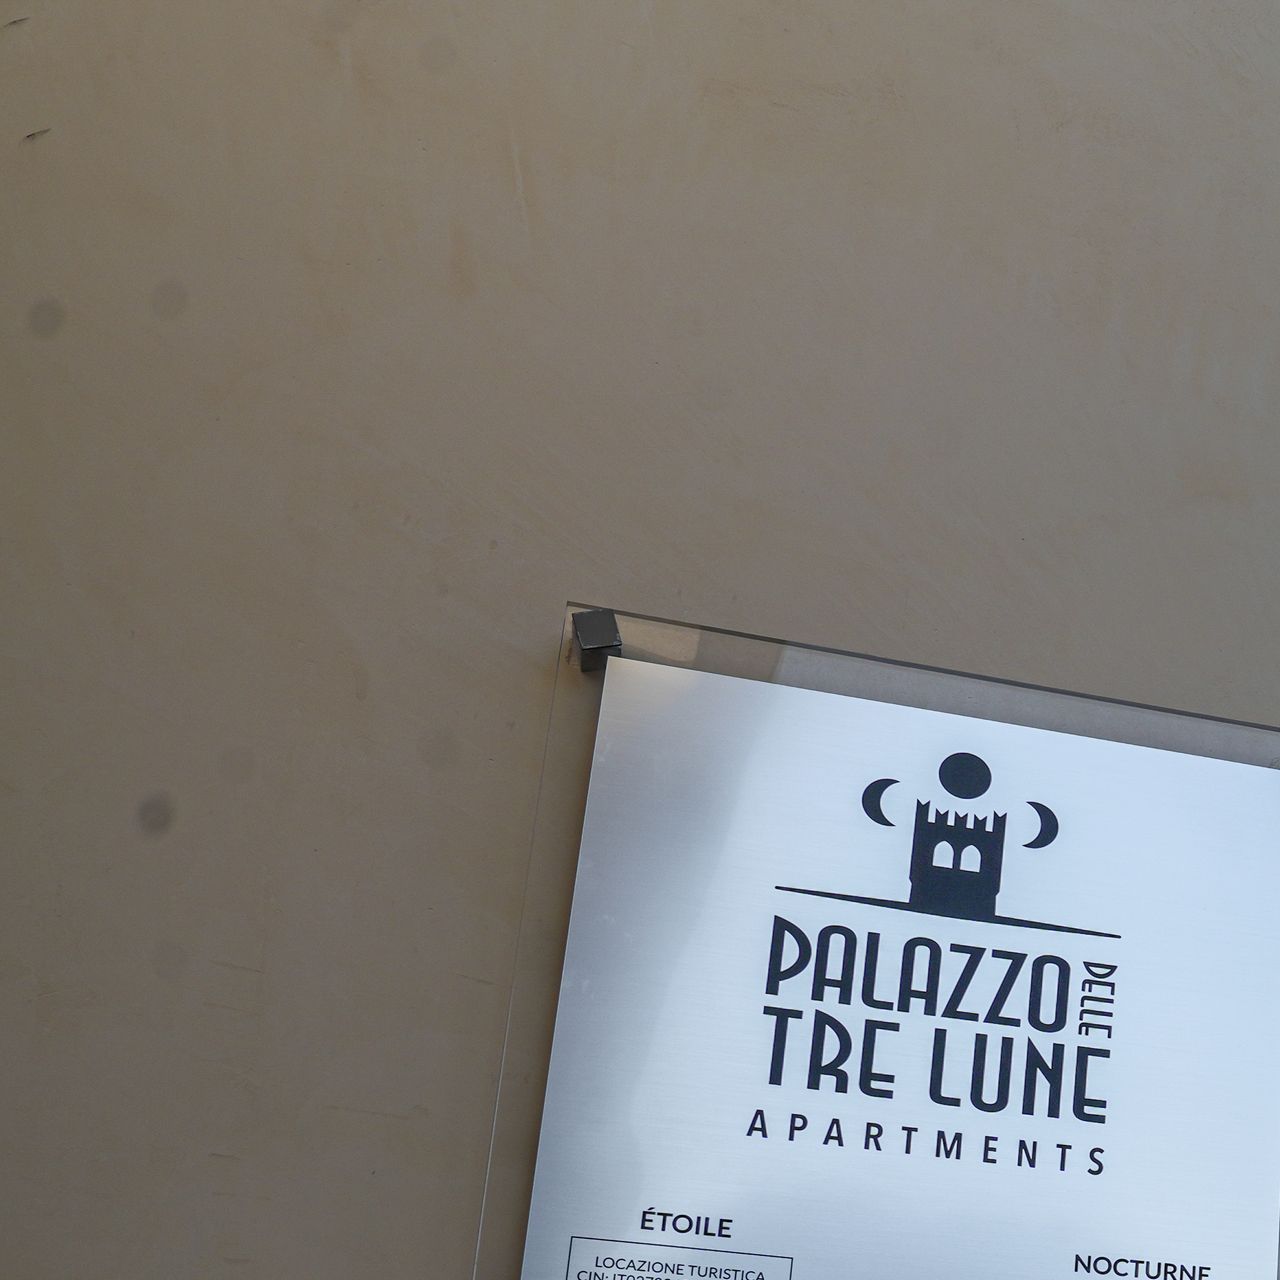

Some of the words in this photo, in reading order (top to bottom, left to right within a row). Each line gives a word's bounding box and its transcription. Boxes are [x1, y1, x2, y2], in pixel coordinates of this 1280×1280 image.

[763, 913, 1072, 1035] PALAZZO
[1078, 960, 1118, 1041] DELLE
[763, 1005, 902, 1101] TRE
[928, 1027, 1112, 1125] LUNE
[746, 1108, 1107, 1177] APARTMENTS
[640, 1206, 733, 1238] ÉTOILE
[595, 1255, 685, 1276] LOCAZIONE
